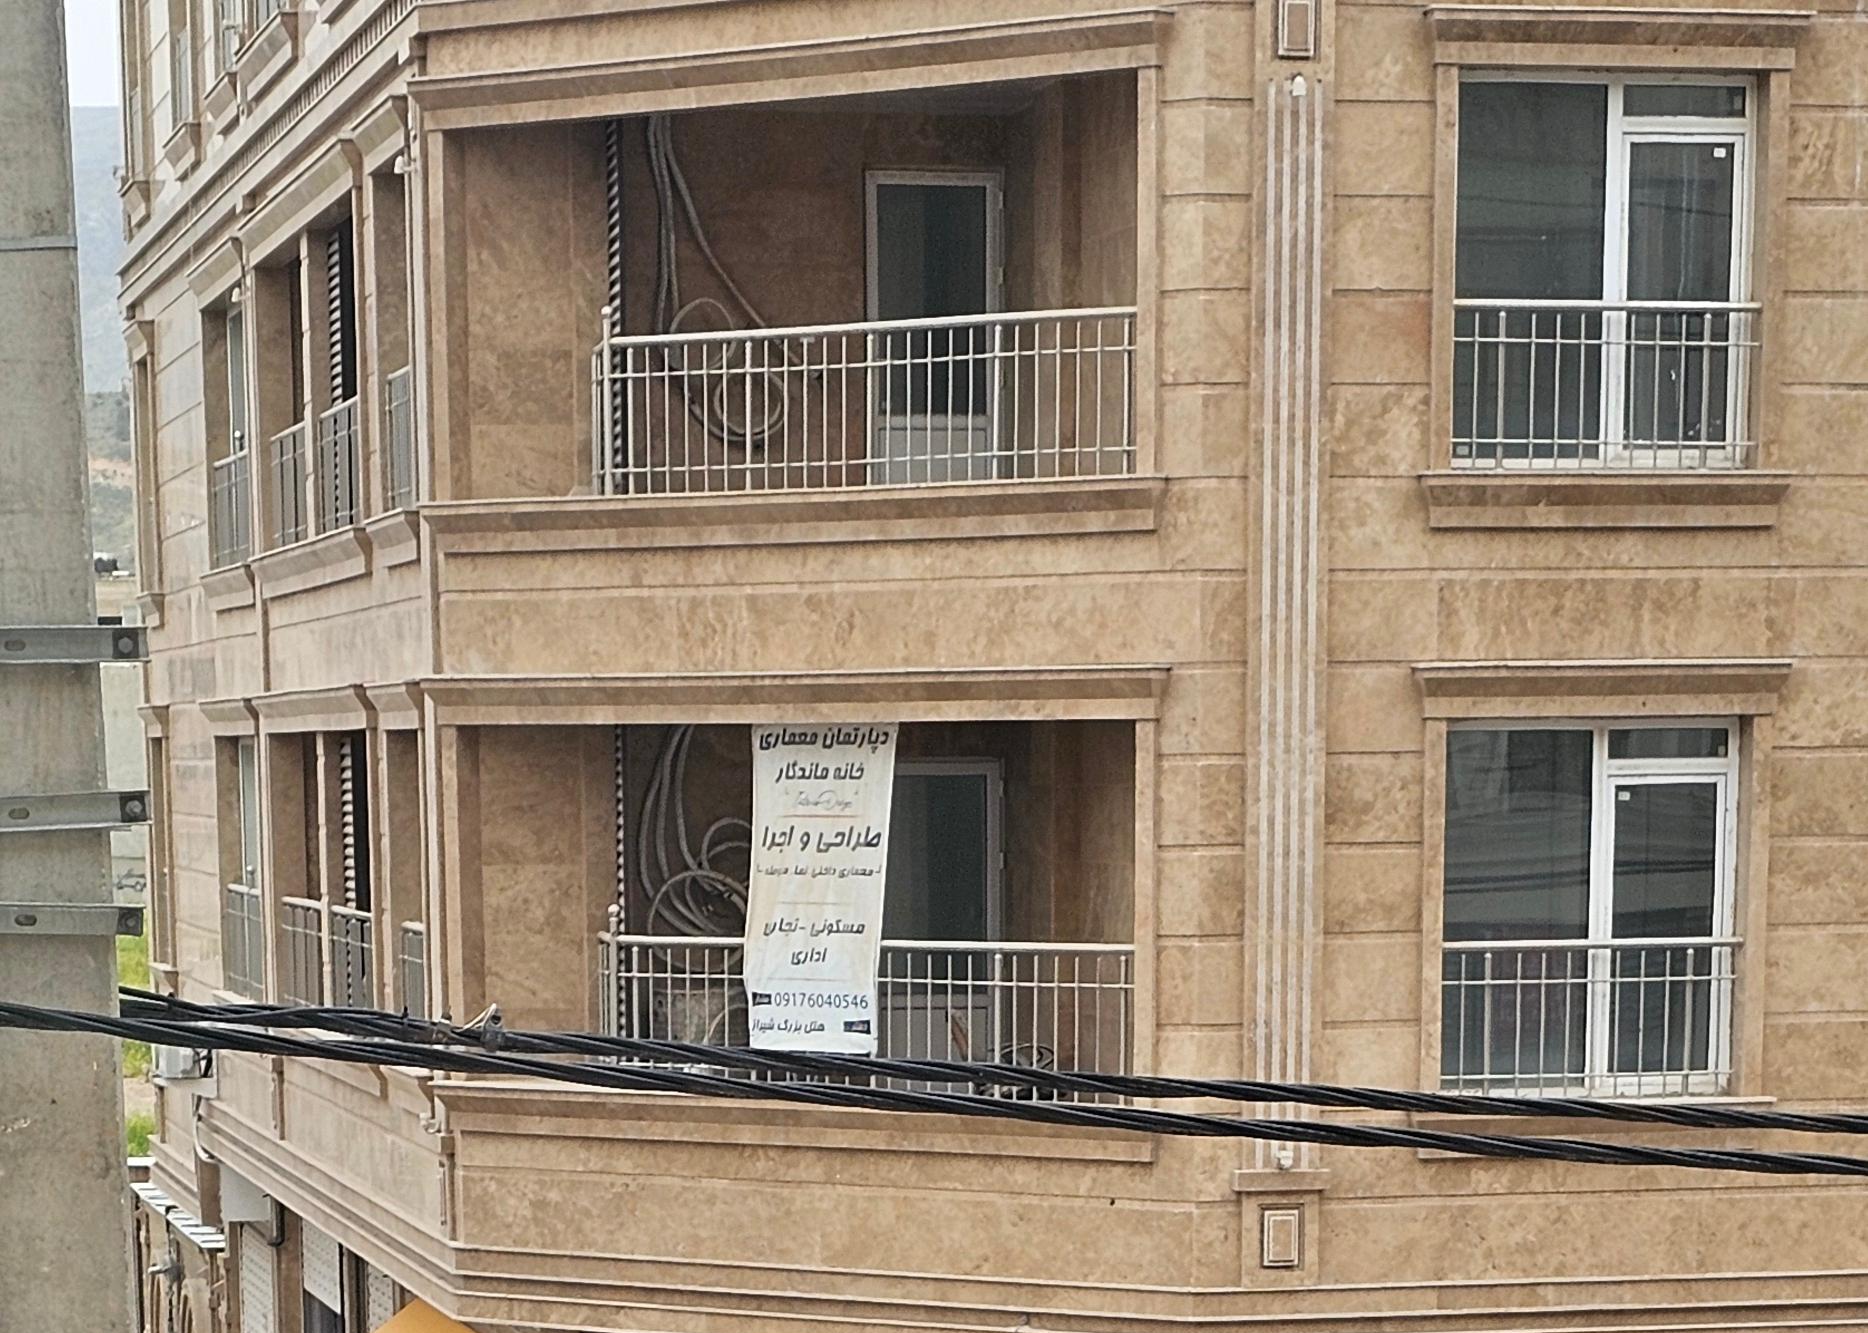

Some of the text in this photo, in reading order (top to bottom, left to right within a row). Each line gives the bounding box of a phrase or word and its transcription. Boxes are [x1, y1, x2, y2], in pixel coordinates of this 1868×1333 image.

[759, 727, 889, 754] دپارتمان معماری
[775, 760, 864, 784] خانه ماندگار
[762, 825, 882, 853] طراحی و اجرا
[810, 920, 865, 937] مسکونی
[791, 948, 827, 965] اداری
[774, 992, 868, 1009] 09176040546
[778, 1019, 802, 1034] بزرگ
[804, 1020, 825, 1034] هتل
